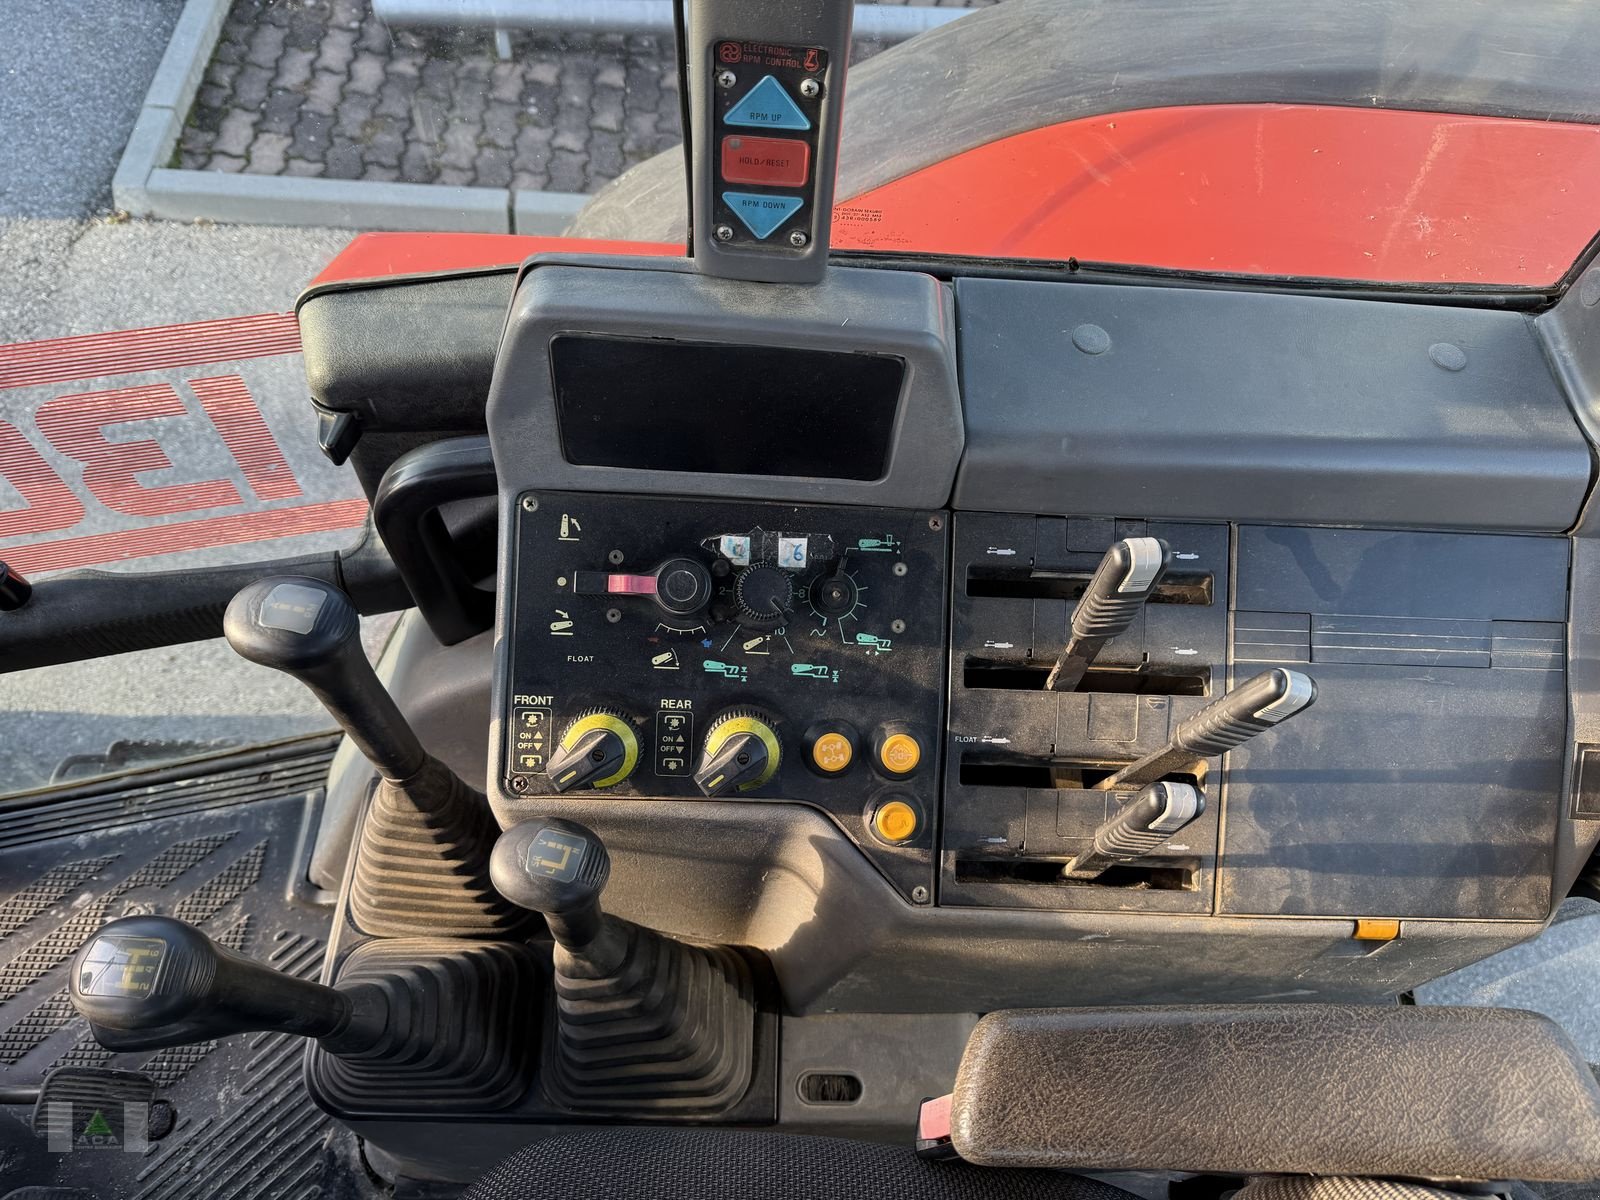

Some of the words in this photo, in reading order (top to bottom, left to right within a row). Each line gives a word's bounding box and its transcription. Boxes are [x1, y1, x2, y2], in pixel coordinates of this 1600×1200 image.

[743, 44, 792, 57] ELECTRONIC
[743, 55, 761, 64] RPM
[765, 57, 801, 68] CONTROL
[750, 112, 768, 121] RPM
[771, 113, 782, 122] UP
[739, 156, 790, 168] HOLD/RESET
[742, 199, 760, 208] RPM
[762, 200, 786, 209] DOWN
[793, 543, 804, 561] 6
[798, 588, 806, 598] 8
[774, 627, 786, 636] 10
[567, 655, 594, 663] FLOAT
[514, 695, 554, 706] FRONT
[660, 699, 692, 709] REAR
[519, 732, 532, 740] ON
[662, 735, 674, 743] ON
[517, 742, 533, 750] OFF
